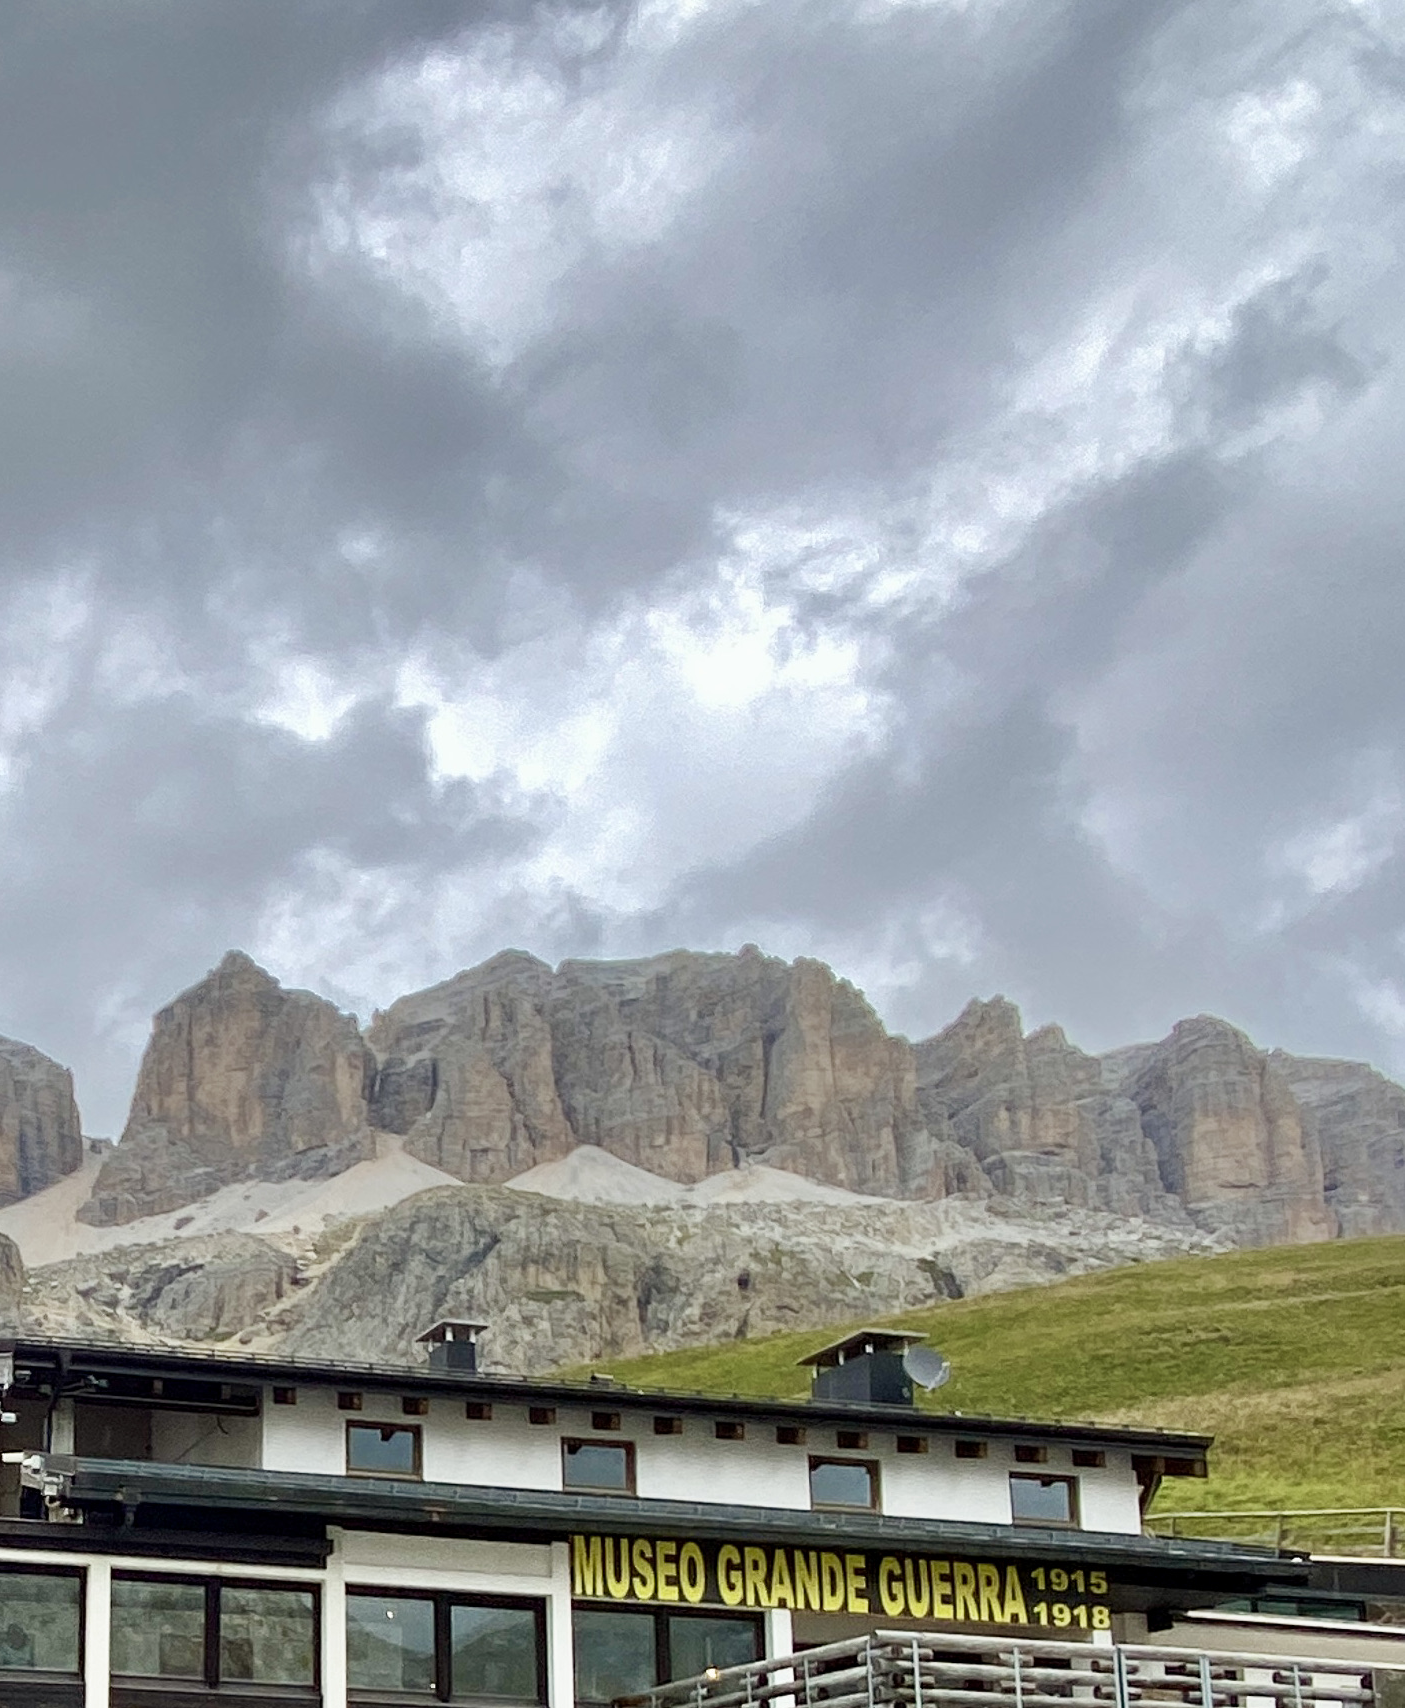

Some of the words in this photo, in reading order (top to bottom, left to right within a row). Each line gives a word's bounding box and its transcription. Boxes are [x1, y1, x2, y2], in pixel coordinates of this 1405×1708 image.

[572, 1534, 706, 1603] MUSEO
[716, 1543, 870, 1615] GRANDE
[878, 1555, 1029, 1625] GUERRA
[1030, 1566, 1109, 1595] 1915
[1033, 1601, 1112, 1630] 1918
